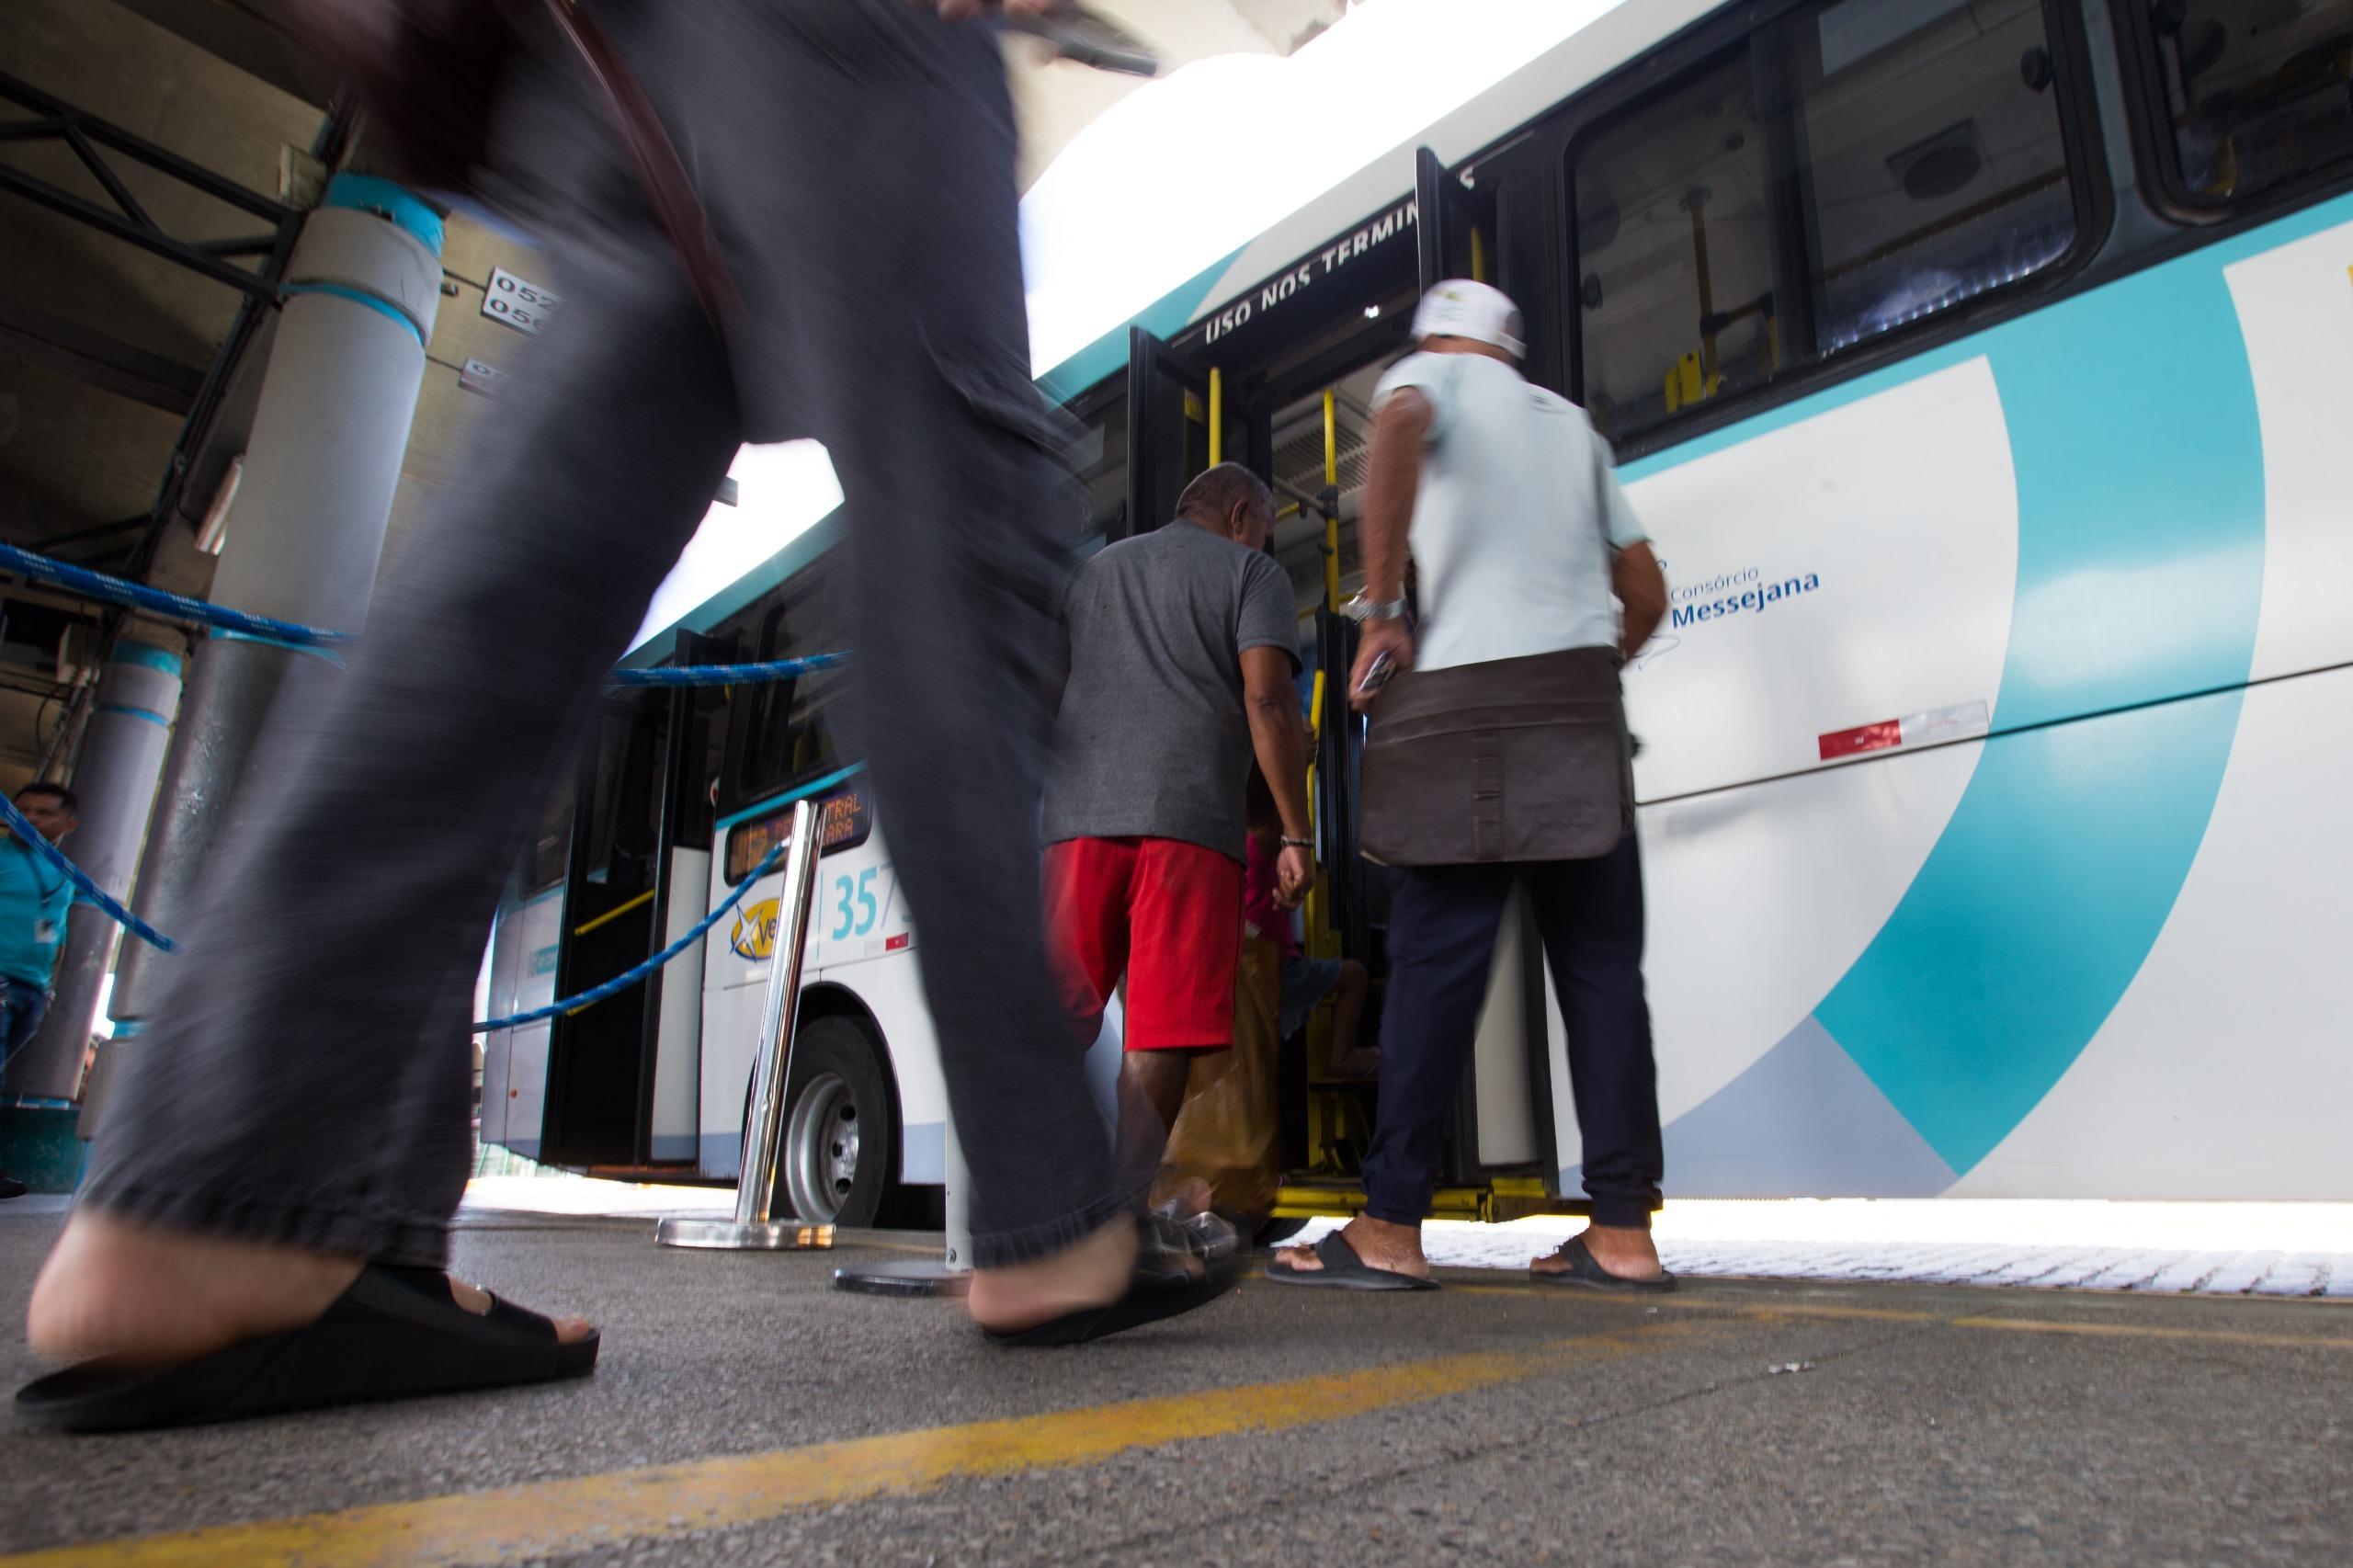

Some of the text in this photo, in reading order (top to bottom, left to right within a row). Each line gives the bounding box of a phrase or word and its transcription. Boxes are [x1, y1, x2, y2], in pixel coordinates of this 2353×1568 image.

[496, 277, 559, 312] 052
[1206, 300, 1251, 345] USO
[1262, 263, 1311, 312] NOS
[1670, 565, 1759, 604] Consórcio
[1672, 572, 1819, 630] Messejana
[824, 793, 862, 822] TRAL
[758, 917, 778, 949] Ve
